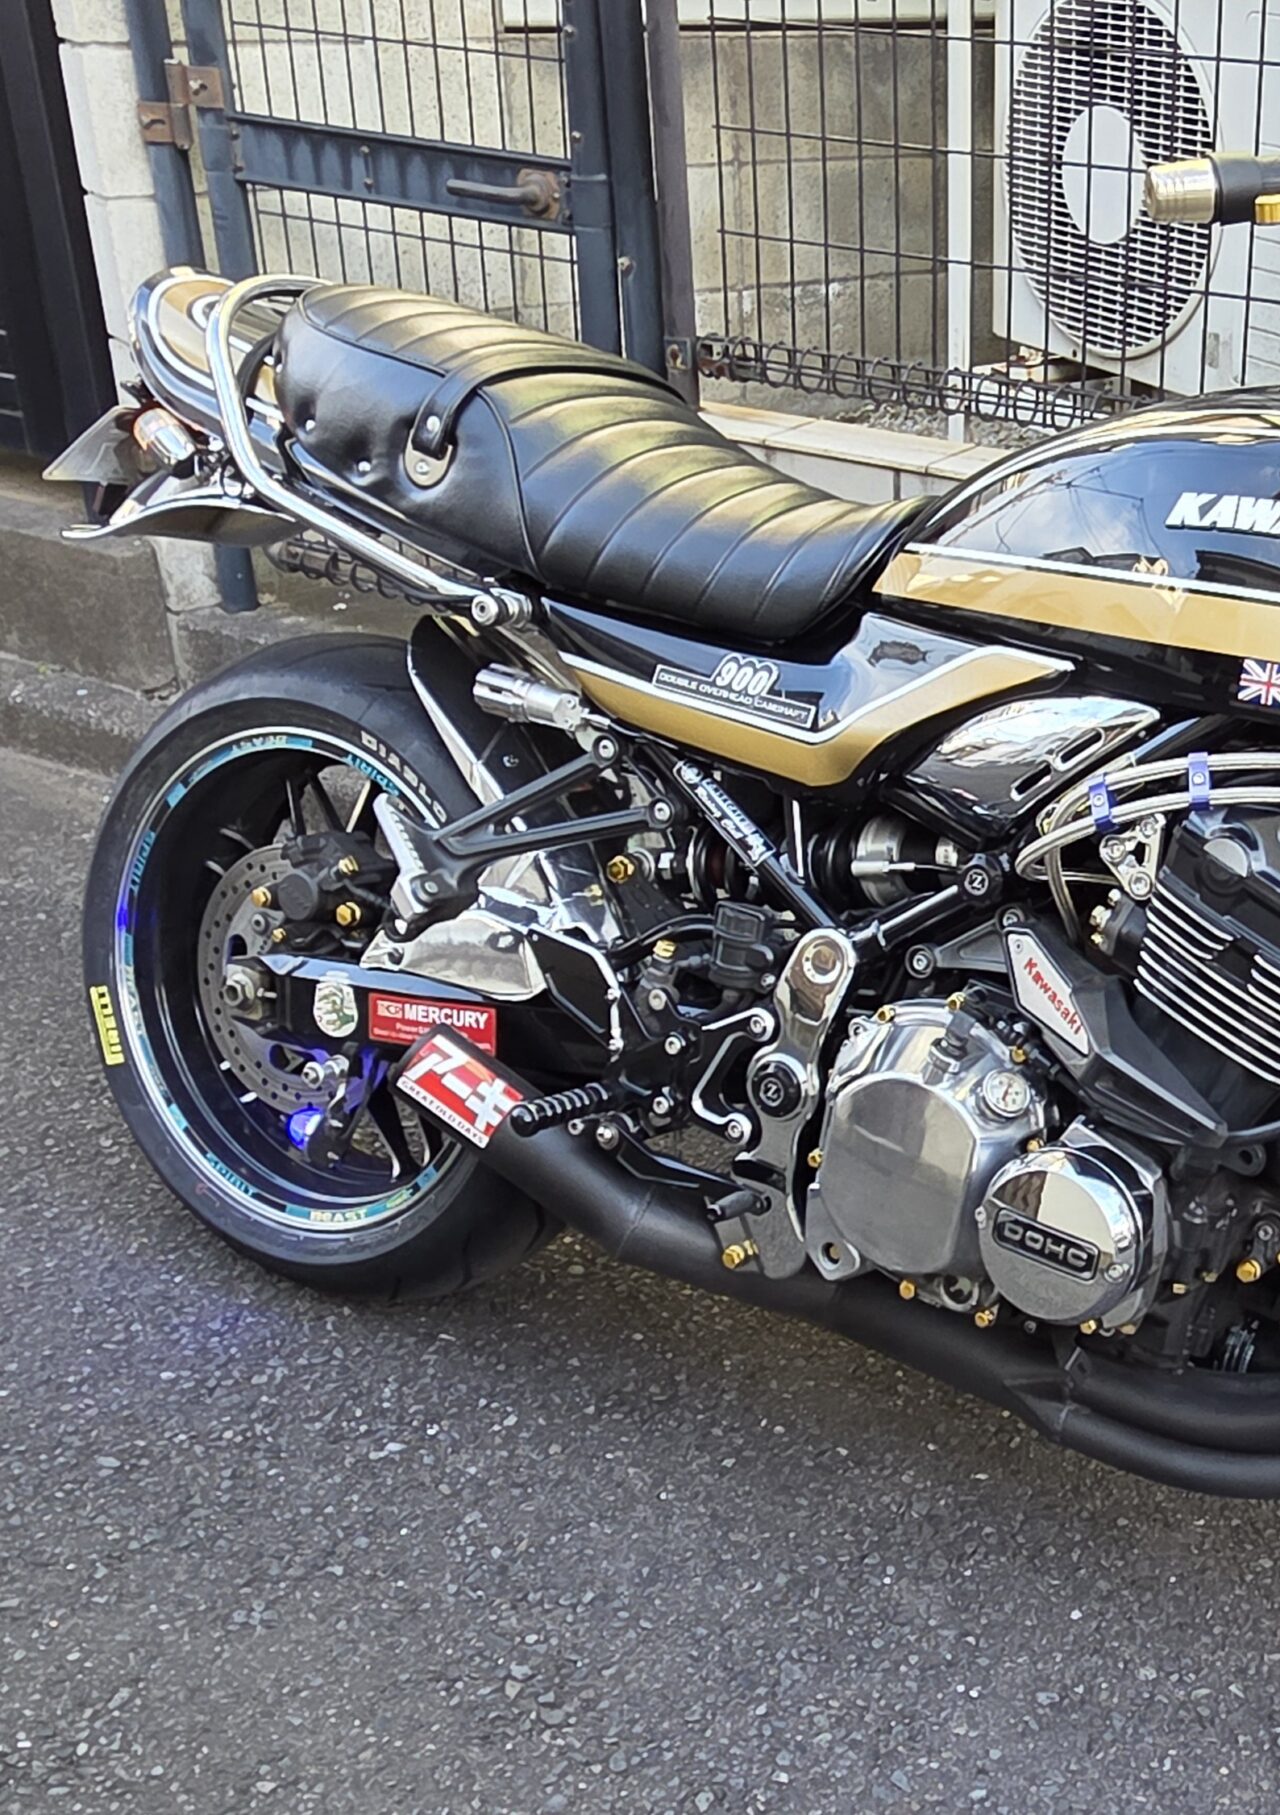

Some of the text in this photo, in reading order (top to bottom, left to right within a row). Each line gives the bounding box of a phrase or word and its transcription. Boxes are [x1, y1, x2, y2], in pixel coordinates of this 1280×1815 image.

[715, 661, 769, 696] 900
[361, 730, 447, 823] DIABLO
[404, 1003, 488, 1030] MERCURY
[1023, 957, 1083, 1035] Kawasaki
[400, 1079, 486, 1144] GREAT OLD DAYS
[310, 1208, 369, 1222] BEAST
[1003, 1222, 1088, 1267] DOHC
